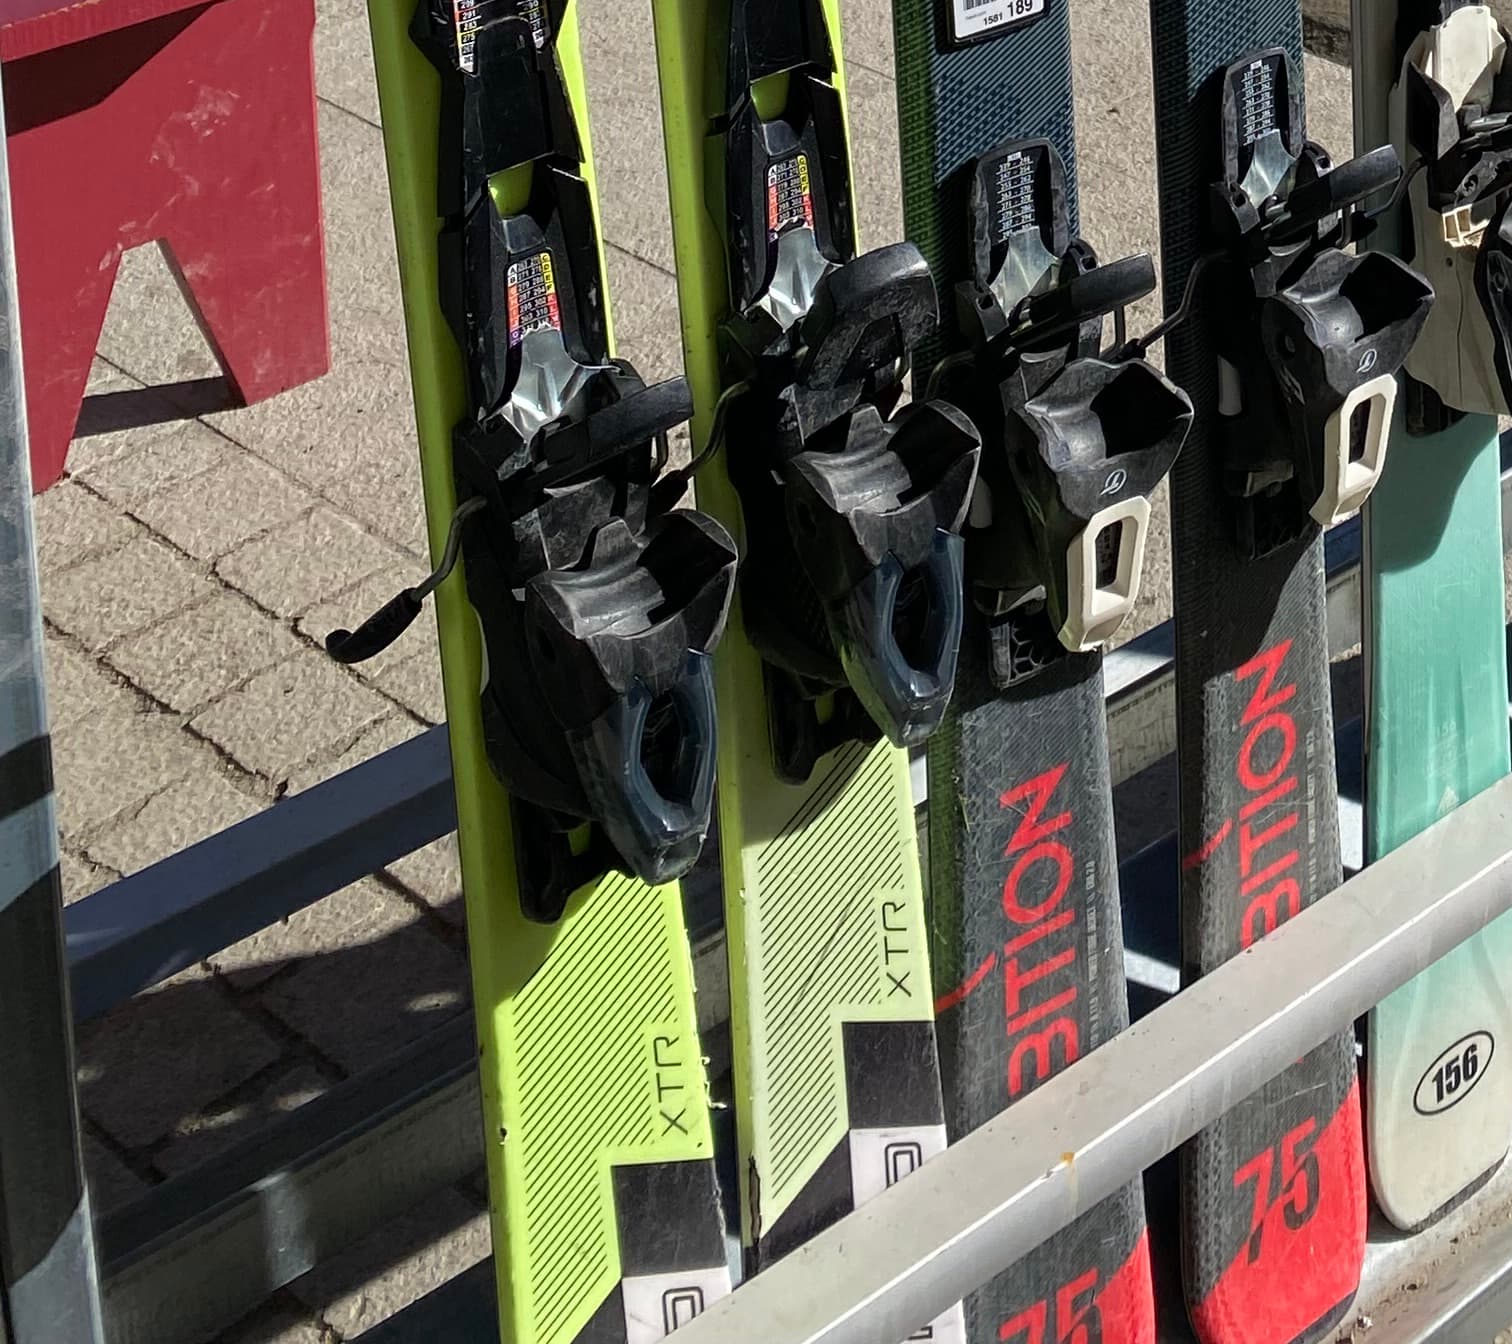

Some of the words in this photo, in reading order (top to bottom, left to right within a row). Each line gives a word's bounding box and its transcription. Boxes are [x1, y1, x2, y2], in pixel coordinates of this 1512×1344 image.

[983, 12, 1003, 26] 1581
[1234, 639, 1300, 952] BITION
[883, 900, 914, 998] XTR
[1000, 762, 1080, 1099] BITION
[653, 1034, 688, 1135] XTR
[1432, 1049, 1479, 1103] 156
[1234, 1117, 1321, 1265] 75
